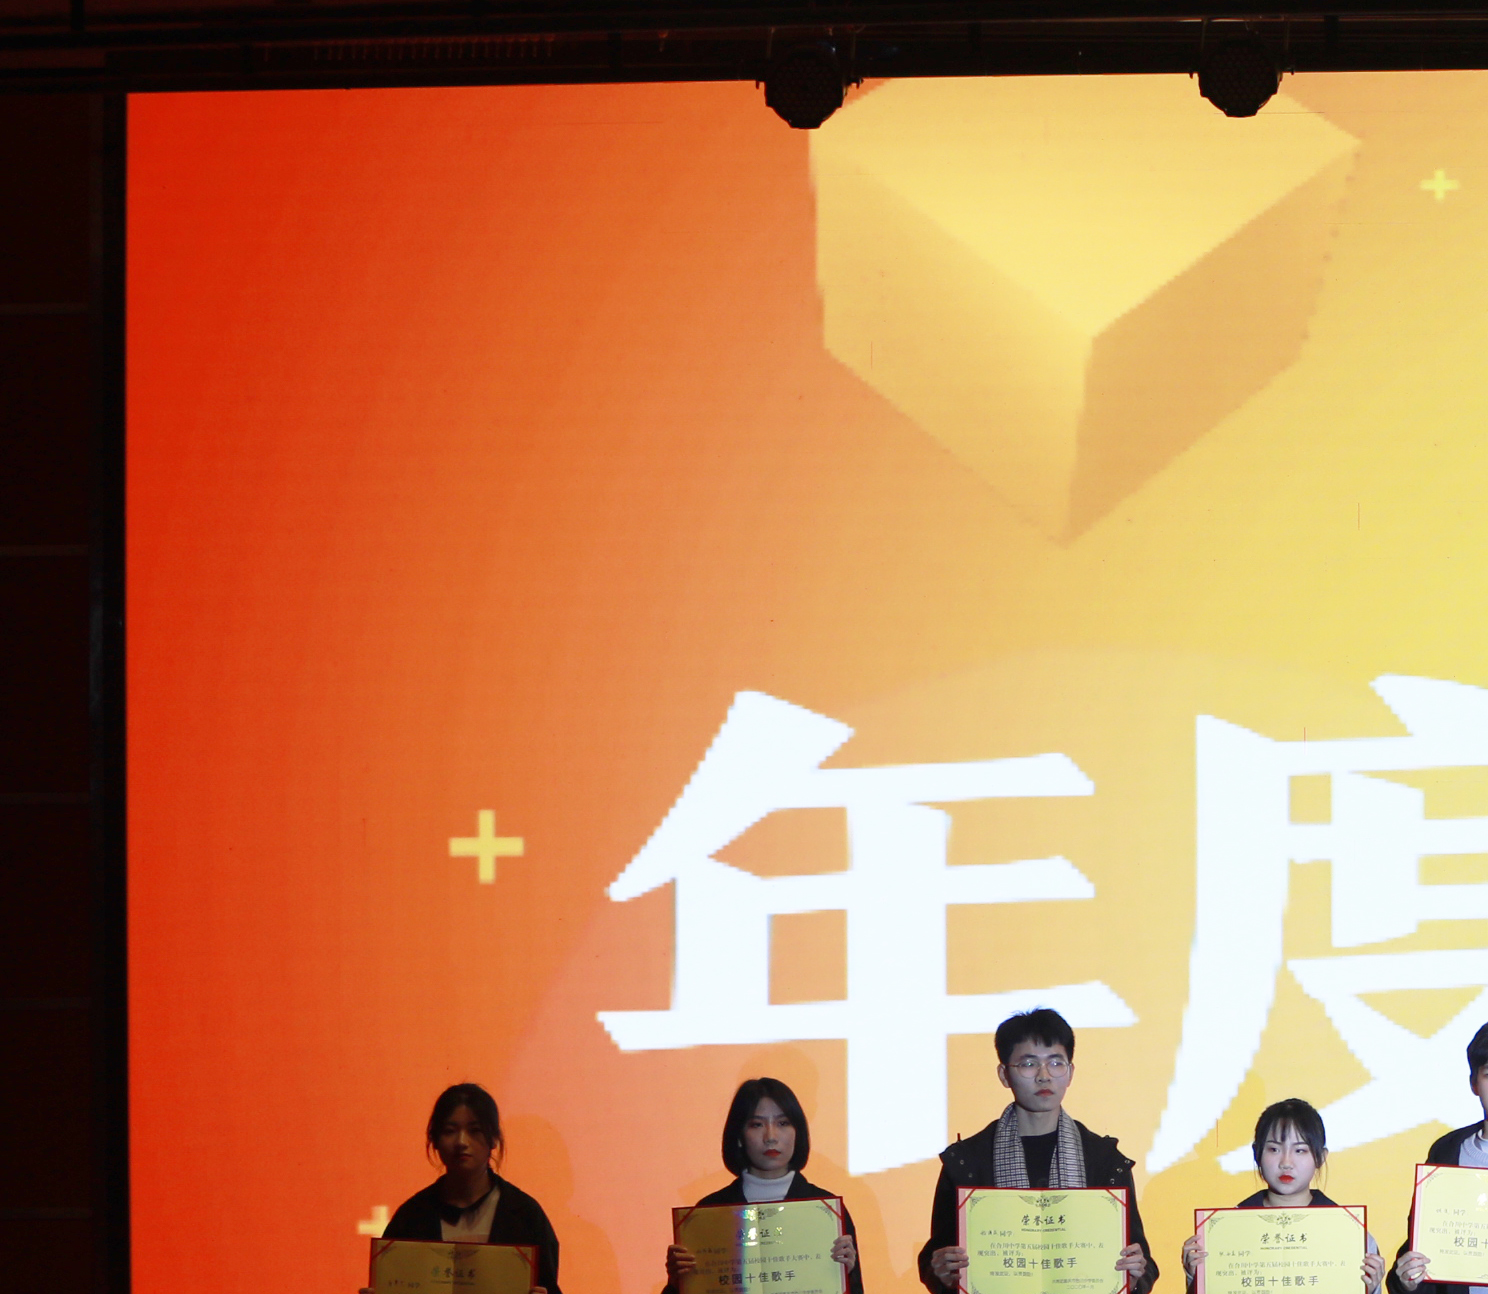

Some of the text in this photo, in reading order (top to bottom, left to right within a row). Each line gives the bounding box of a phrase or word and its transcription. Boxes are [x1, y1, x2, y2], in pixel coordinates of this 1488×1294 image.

[1021, 1215, 1066, 1226] 荣誉证书
[1261, 1233, 1308, 1243] 荣誉证书
[1003, 1257, 1077, 1269] 校园十佳歌手
[719, 1270, 796, 1285] 校园十佳歌手
[1241, 1276, 1319, 1287] 校园十佳歌手
